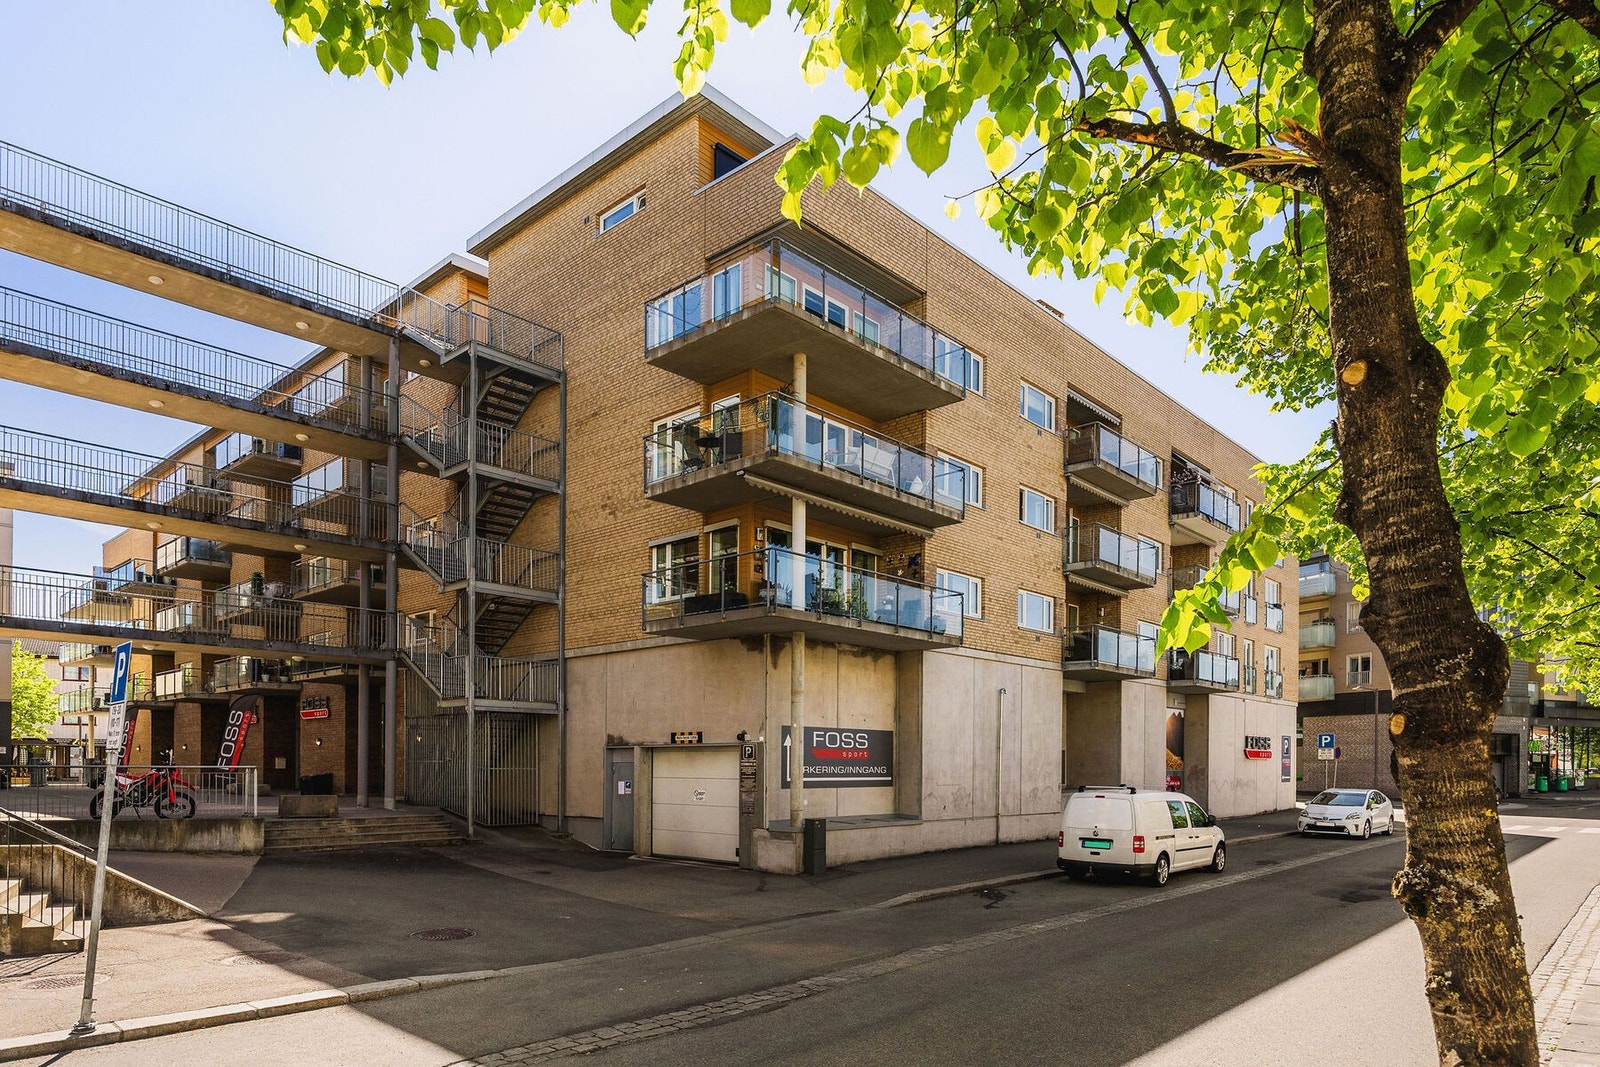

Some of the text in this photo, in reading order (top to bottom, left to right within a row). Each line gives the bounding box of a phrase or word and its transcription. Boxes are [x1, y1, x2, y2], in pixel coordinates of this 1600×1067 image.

[114, 652, 126, 695] P
[217, 710, 244, 771] FOSS
[813, 731, 868, 749] FOSS
[1245, 735, 1271, 750] FOSS
[1321, 735, 1331, 747] P
[745, 746, 752, 758] P
[842, 751, 868, 759] sport
[803, 765, 887, 775] RKERING/INNGANG
